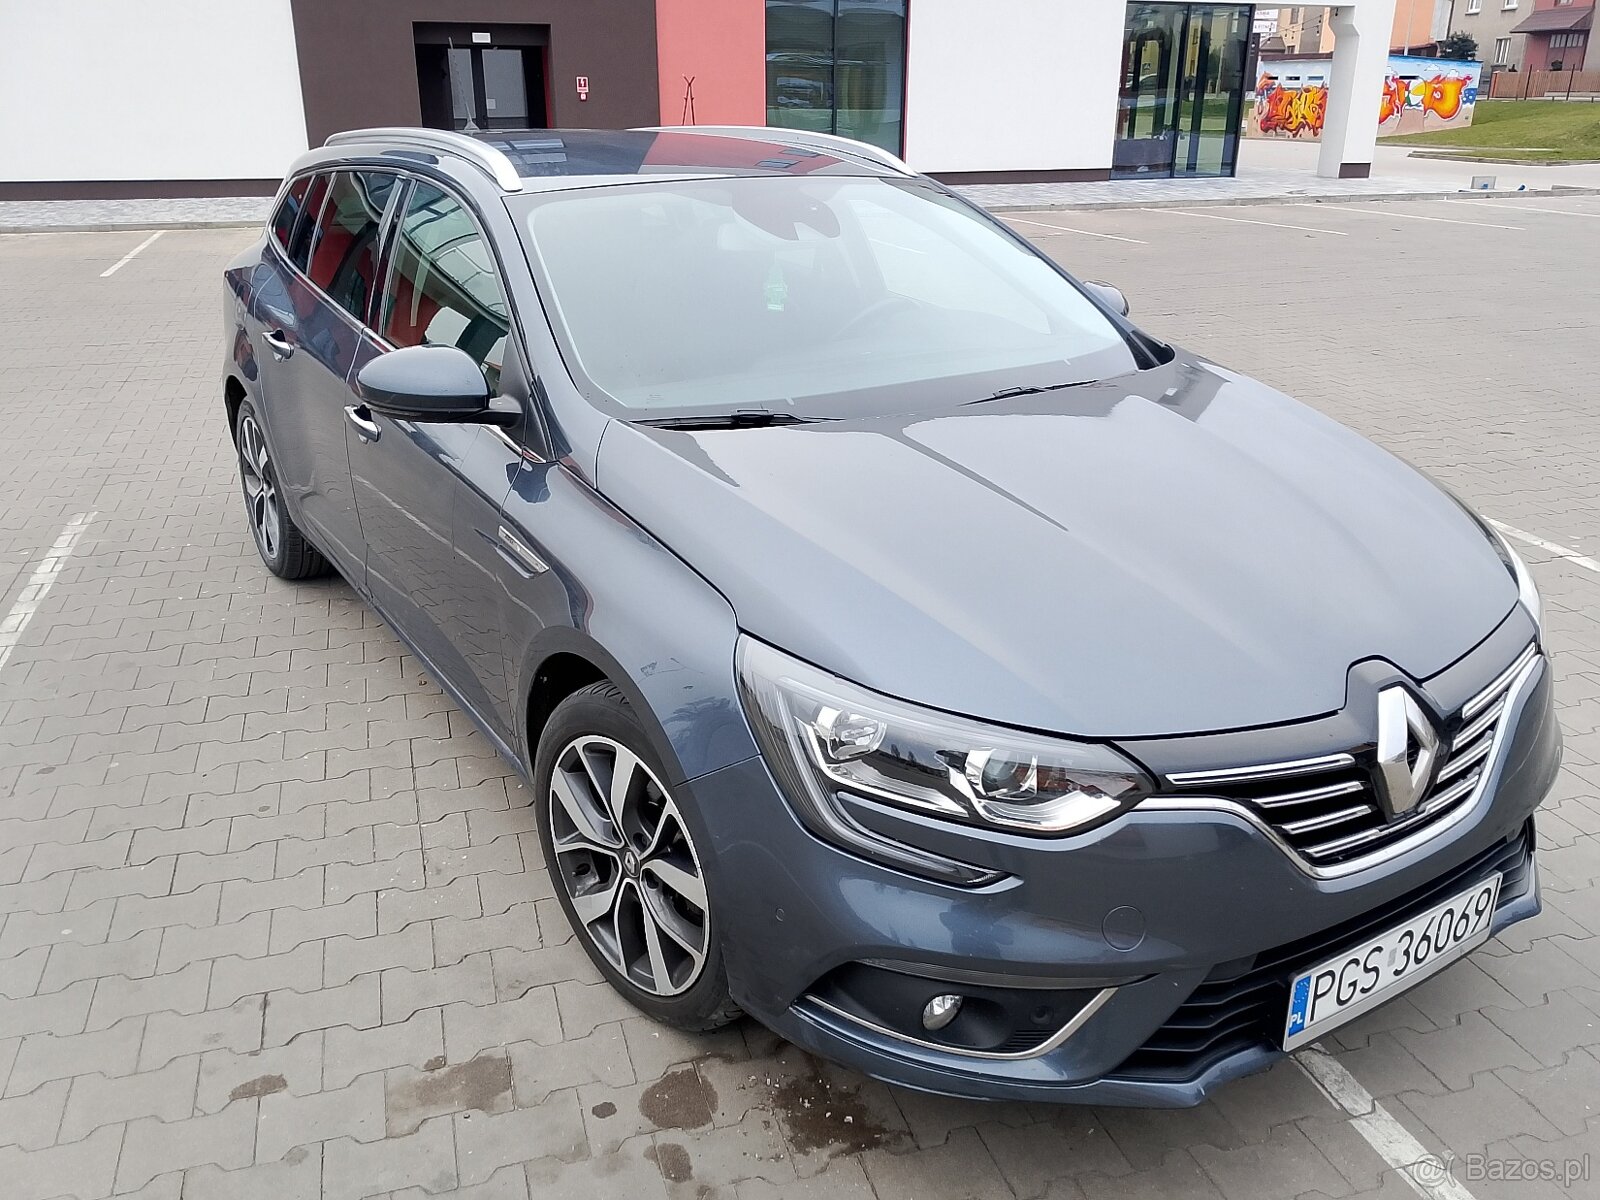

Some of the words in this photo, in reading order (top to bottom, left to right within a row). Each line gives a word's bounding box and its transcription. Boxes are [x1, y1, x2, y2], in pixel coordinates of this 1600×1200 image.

[1309, 945, 1384, 1023] PGS
[1393, 887, 1491, 977] 36069
[1289, 1011, 1304, 1028] PL
